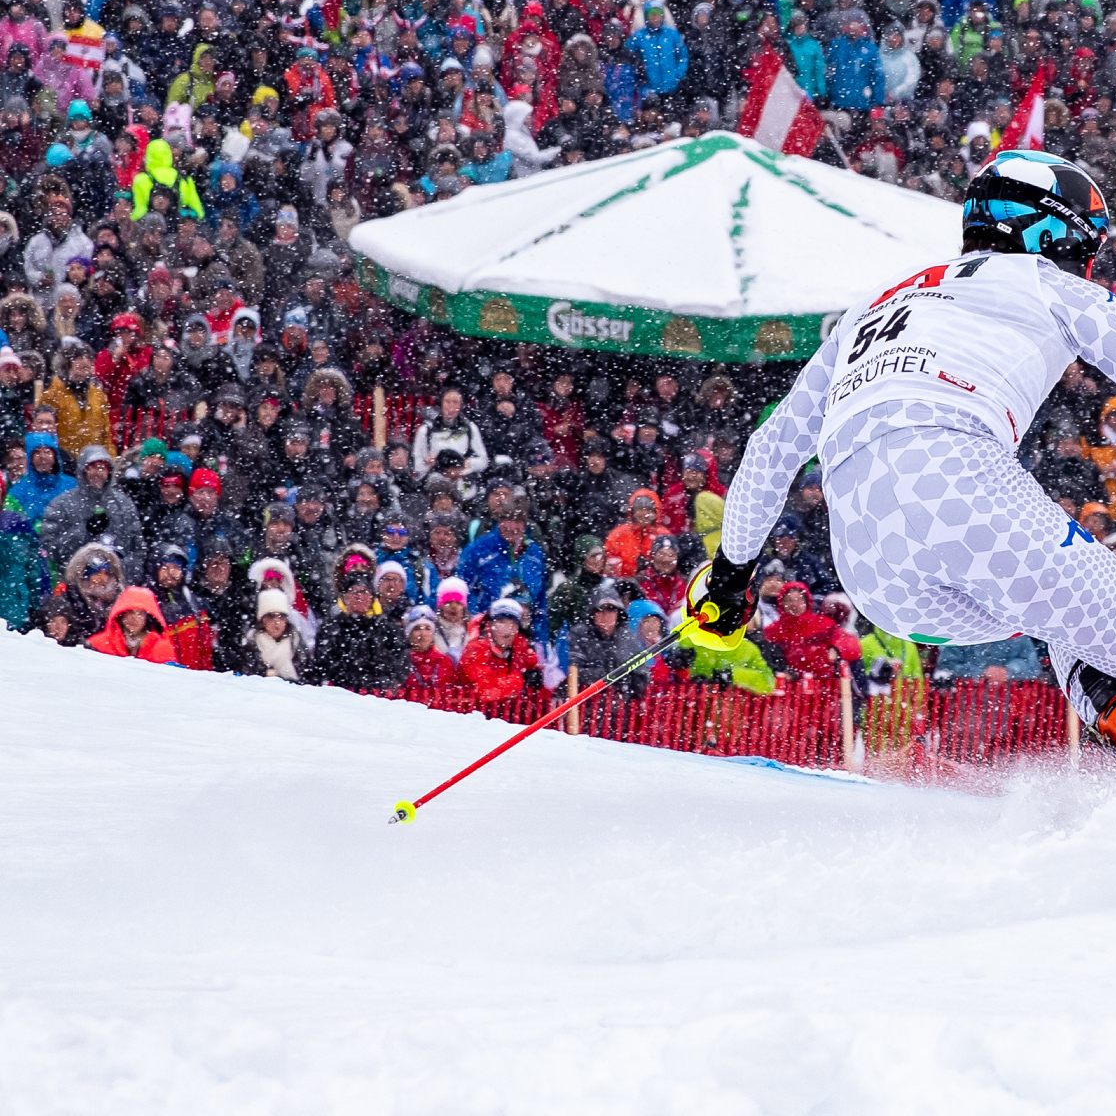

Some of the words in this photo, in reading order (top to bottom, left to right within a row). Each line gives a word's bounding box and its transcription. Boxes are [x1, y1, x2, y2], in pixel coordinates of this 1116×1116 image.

[854, 297, 898, 326] Smart
[900, 290, 955, 304] Home
[847, 304, 912, 365] 54
